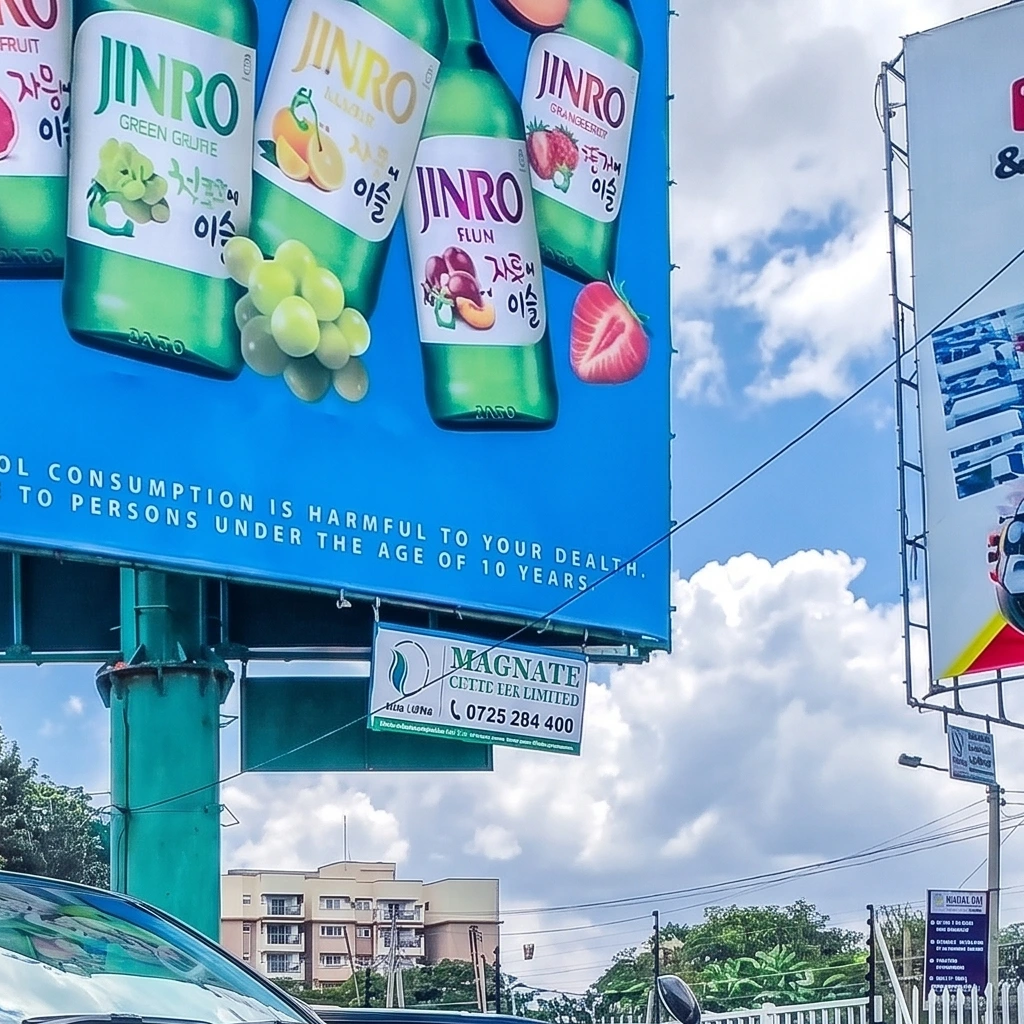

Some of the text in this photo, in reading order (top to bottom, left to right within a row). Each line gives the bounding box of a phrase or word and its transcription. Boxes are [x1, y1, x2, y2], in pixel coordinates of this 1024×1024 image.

[94, 35, 238, 136] JINRO
[291, 11, 416, 124] JINRO
[535, 50, 626, 128] JINRO
[119, 114, 167, 142] GREEN
[354, 178, 390, 223] 이슬
[416, 166, 523, 233] JINRO
[592, 177, 616, 212] 이슬
[508, 283, 540, 328] 이슬
[19, 485, 52, 507] TO
[72, 493, 197, 529] PERSONS
[215, 515, 301, 545] UNDER
[317, 532, 362, 555] THE
[378, 542, 423, 564] AGE
[438, 551, 466, 570] OF
[482, 559, 505, 577] 10
[48, 463, 253, 512] CONSUMPTION
[270, 499, 292, 518] IS
[309, 505, 426, 540] HARMFUL
[440, 527, 468, 547] TO
[482, 534, 541, 560] YOUR
[450, 646, 581, 688] MAGNATE
[466, 704, 574, 734] 0725 284 400
[523, 686, 580, 707] LIMITED
